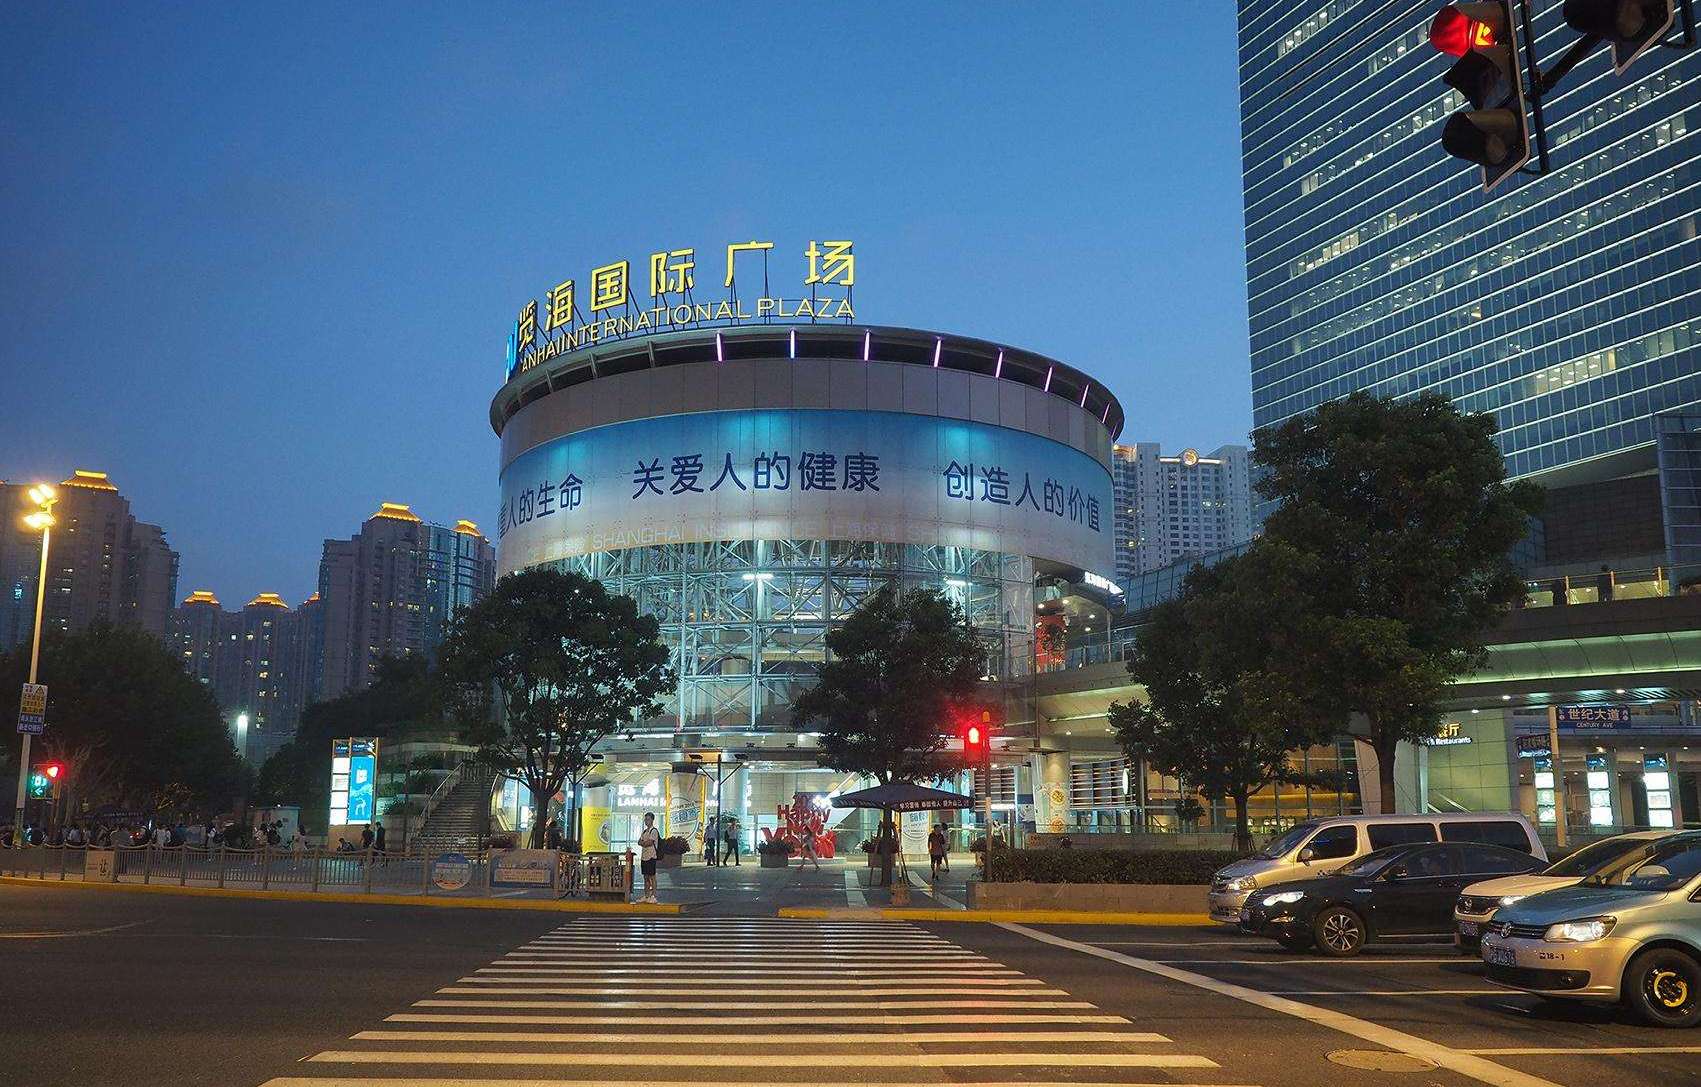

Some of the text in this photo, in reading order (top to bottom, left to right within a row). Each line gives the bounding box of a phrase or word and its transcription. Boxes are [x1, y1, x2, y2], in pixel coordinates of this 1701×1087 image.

[518, 240, 855, 353] 览海国际广场
[521, 338, 560, 373] ANHAI
[757, 298, 855, 319] PLAZA
[632, 451, 880, 500] 关爱人的健康
[943, 460, 1101, 533] 创造人的价值
[592, 526, 686, 550] SHANGHAI
[694, 520, 819, 541] INSNCE
[1568, 708, 1620, 721] 世纪大道
[1435, 736, 1472, 746] Restaurants
